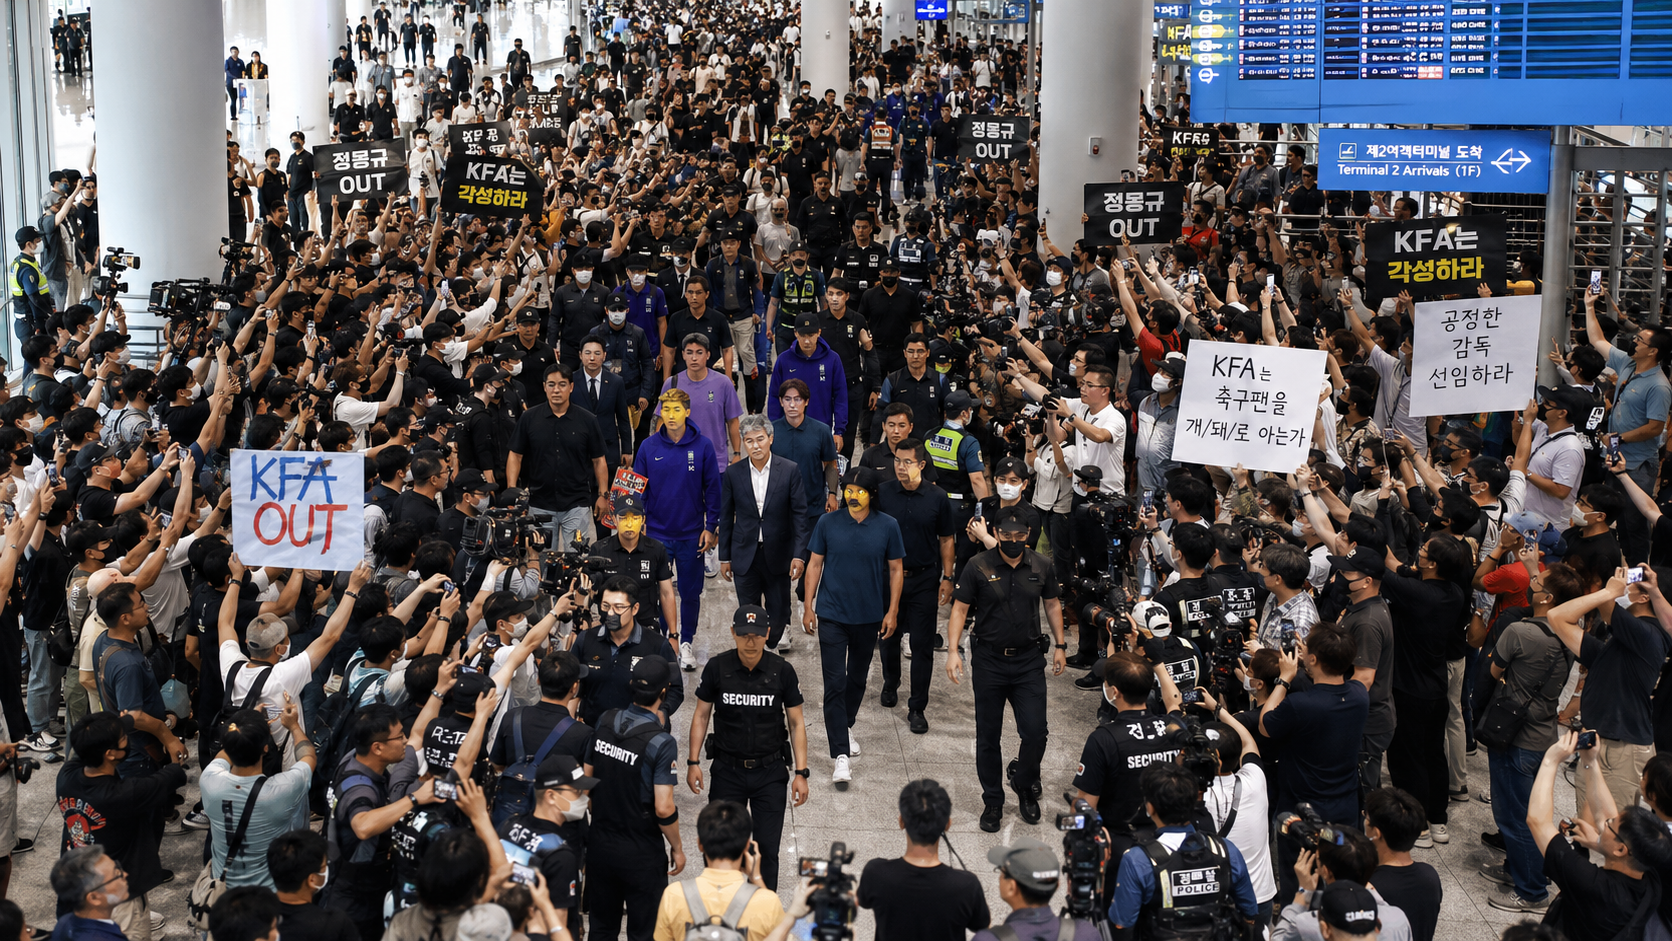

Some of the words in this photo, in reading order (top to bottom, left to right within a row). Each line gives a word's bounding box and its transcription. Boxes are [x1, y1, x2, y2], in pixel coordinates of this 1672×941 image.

[971, 121, 1015, 139] 정몽규
[332, 148, 389, 171] 정몽규
[975, 142, 1012, 159] OUT
[1455, 145, 1483, 159] 도착
[466, 161, 527, 186] KFA는
[1338, 164, 1389, 176] Terminal
[1391, 165, 1400, 176] 2
[1402, 164, 1450, 177] Arrivals
[1455, 165, 1481, 178] (1F)
[339, 172, 387, 195] OUT
[458, 184, 528, 210] 각성하라
[1103, 191, 1165, 213] 정몽규
[1109, 217, 1160, 238] OUT
[1394, 226, 1479, 253] KFA는
[1387, 256, 1485, 283] 각성하라
[1440, 306, 1503, 333] 공정한
[1452, 336, 1491, 360] 감독
[1428, 362, 1514, 390] 선임하라
[1185, 418, 1250, 442] 개/돼/로
[1258, 425, 1306, 448] 아는가
[250, 454, 338, 504] KFA
[253, 501, 348, 555] OUT
[722, 692, 775, 707] SECURITY
[594, 738, 639, 766] SECURITY
[1177, 883, 1219, 895] POLICE
